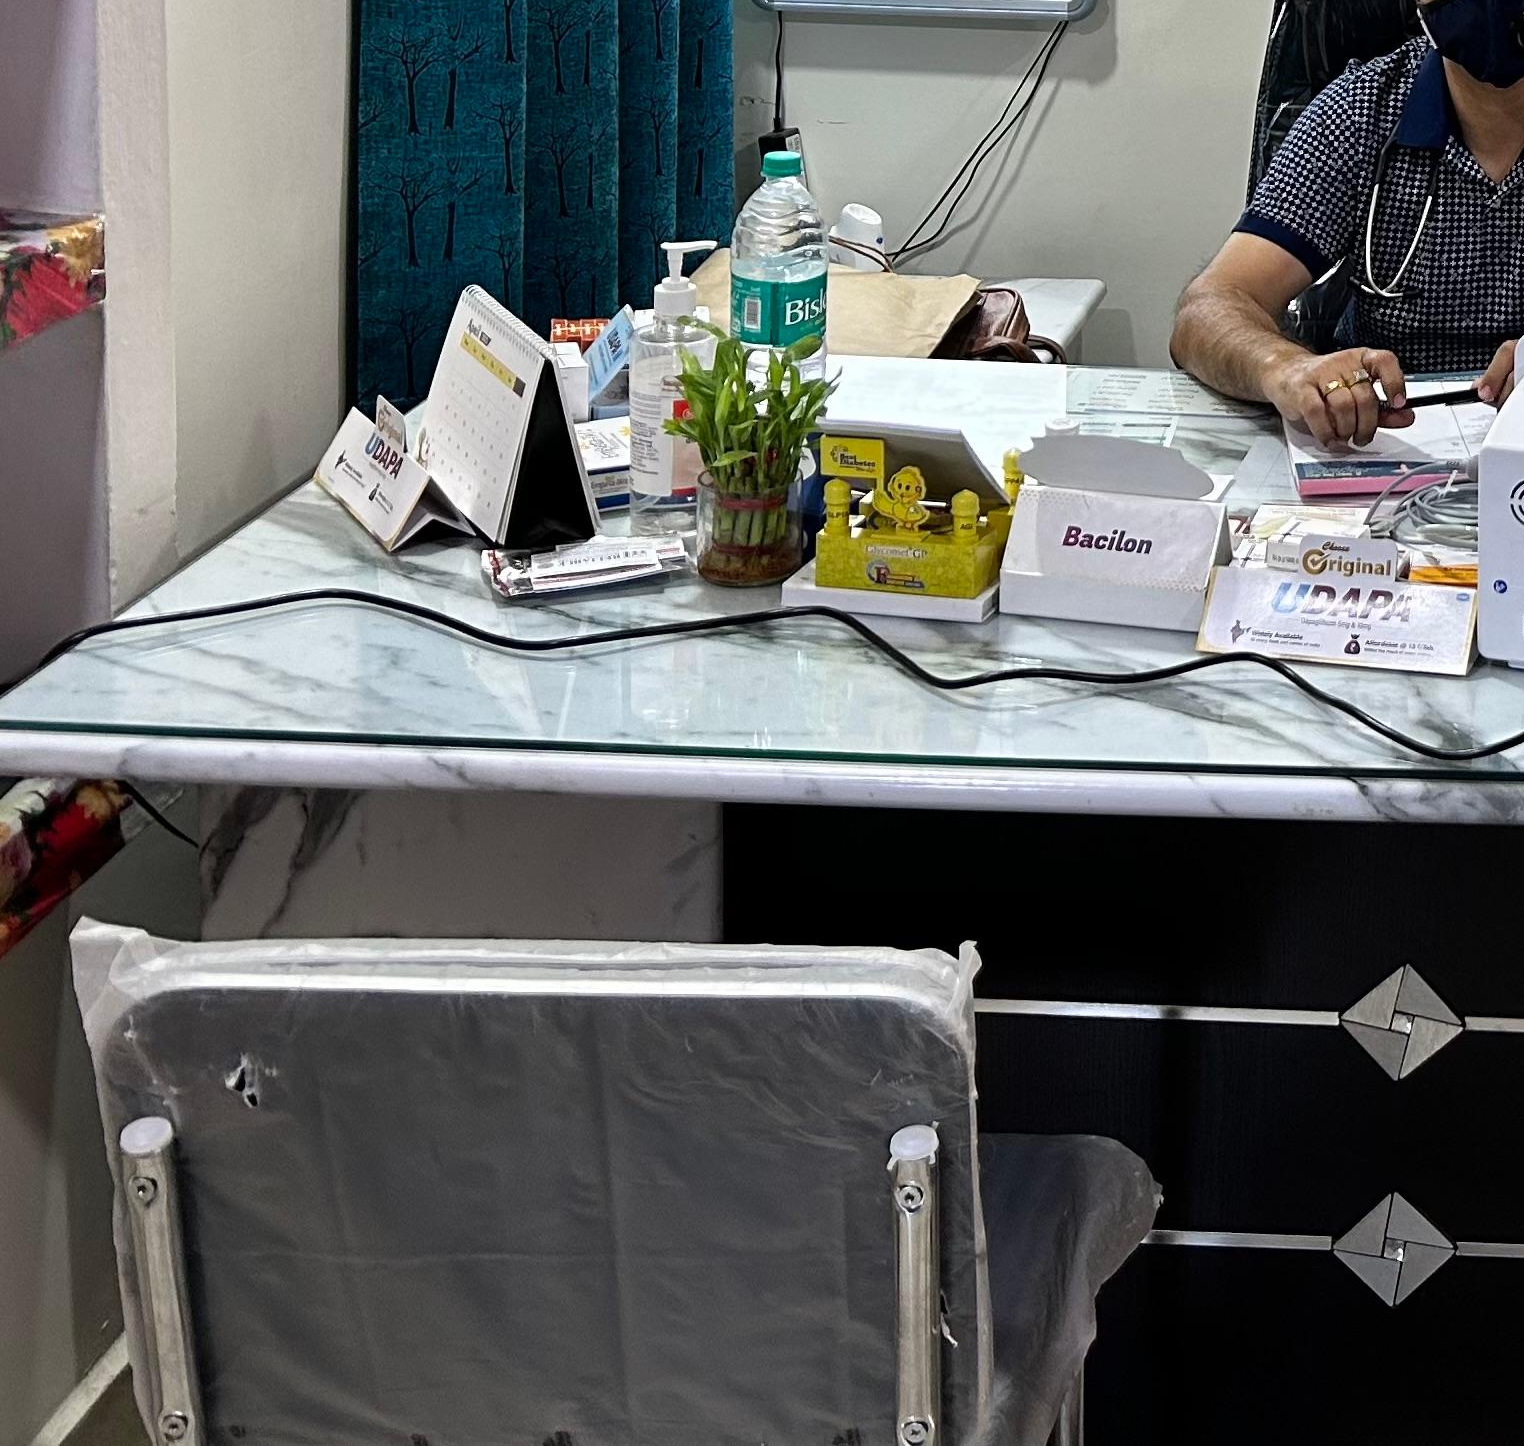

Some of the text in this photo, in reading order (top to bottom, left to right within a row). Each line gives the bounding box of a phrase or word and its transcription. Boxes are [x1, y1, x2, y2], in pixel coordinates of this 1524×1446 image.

[364, 432, 404, 480] UDAPA
[1062, 525, 1152, 554] Bacilon
[1302, 548, 1392, 577] Original
[1272, 582, 1412, 622] UDAPA
